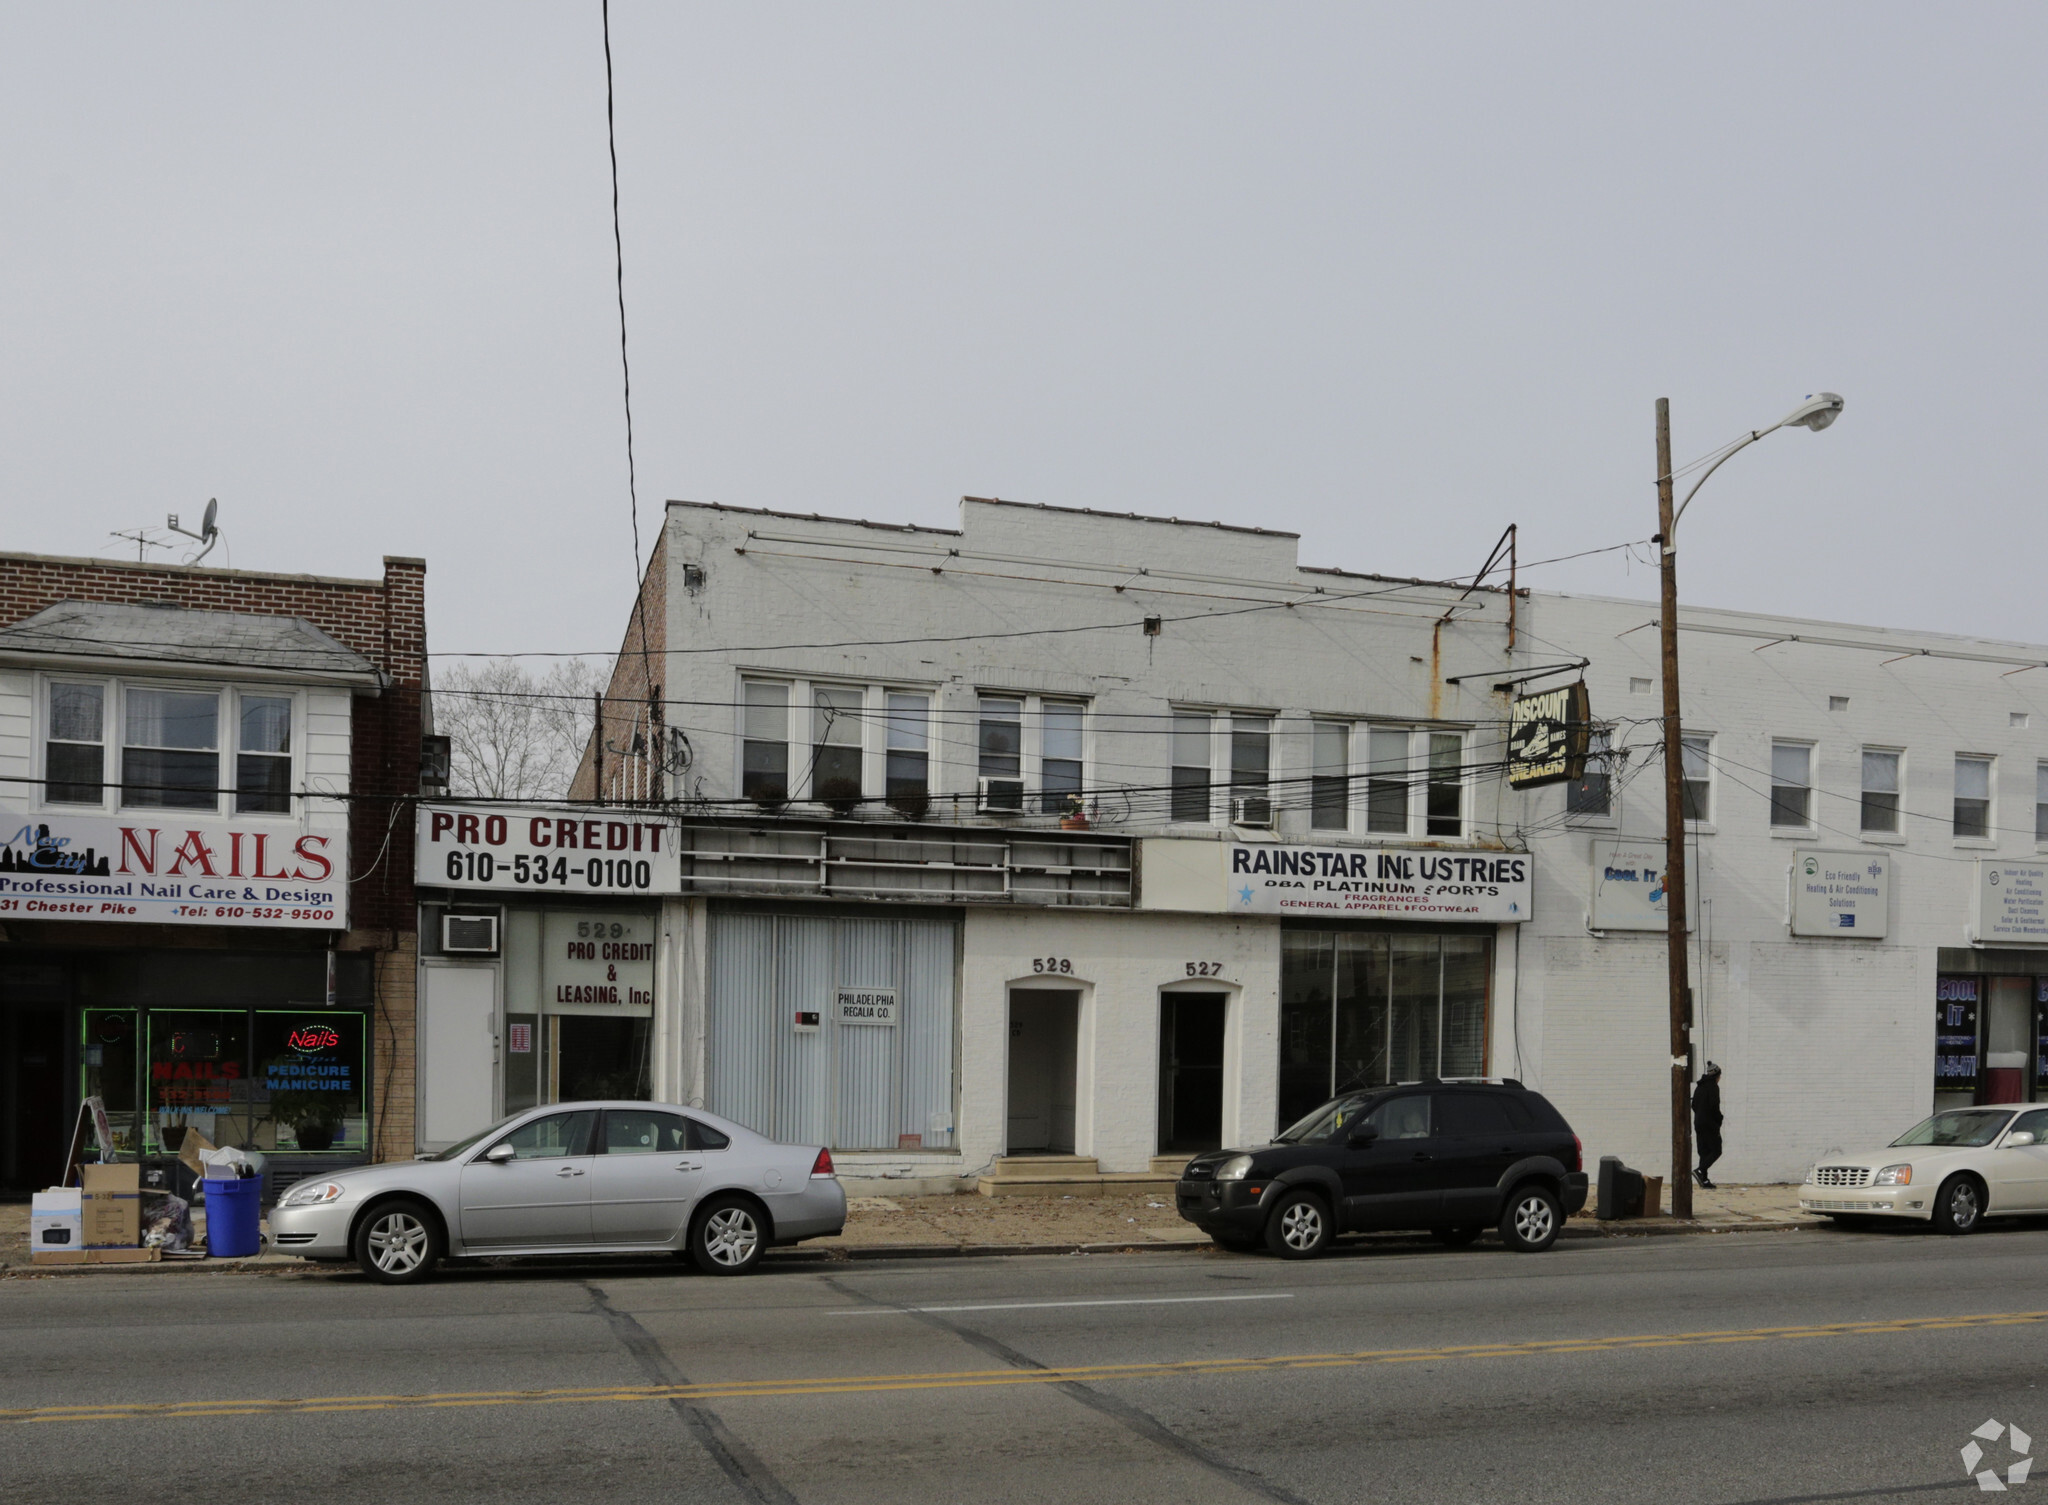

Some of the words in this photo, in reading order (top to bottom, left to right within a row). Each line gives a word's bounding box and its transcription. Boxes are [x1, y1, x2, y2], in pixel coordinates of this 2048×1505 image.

[1511, 688, 1569, 739] DISCOUNT
[0, 824, 71, 847] New
[431, 812, 507, 845] PRO
[529, 816, 667, 853] CREDIT
[30, 847, 86, 875] City
[115, 826, 334, 883] NAILS
[1233, 848, 1367, 878] RAINSTAR
[446, 850, 650, 889] 610-534-0100
[1825, 870, 1836, 880] Eco
[1838, 871, 1860, 882] Friendly
[0, 877, 132, 896] Professional
[141, 882, 182, 898] Nail
[189, 884, 236, 900] Care
[243, 886, 259, 901] &
[266, 887, 333, 906] Design
[1264, 880, 1306, 889] DBA
[1313, 880, 1415, 894] PLATINUM
[1806, 883, 1827, 894] Heating
[1829, 884, 1833, 893] &
[1835, 885, 1844, 894] Air
[1845, 884, 1878, 896] Conditioning
[1279, 900, 1340, 909] GENERAL
[1344, 903, 1401, 911] APPAREL
[1411, 905, 1479, 913] FOOTWEAR
[1344, 894, 1429, 903] FRAGRANCES
[1829, 897, 1856, 908] Solutions
[26, 900, 93, 913] Chester
[100, 903, 137, 914] Pike
[179, 905, 208, 917] Tel:
[215, 906, 334, 921] 610-532-9500
[577, 921, 623, 939] 529
[567, 941, 596, 960] PRO
[602, 942, 653, 961] CREDIT
[607, 963, 617, 982] &
[1033, 957, 1071, 974] 529
[1186, 961, 1223, 977] 527
[557, 985, 622, 1005] LEASING,
[1937, 977, 1977, 1001] COOL
[838, 993, 895, 1006] PHILADELPHIA
[843, 1006, 875, 1018] REGALIA
[877, 1007, 891, 1019] CO.
[1946, 1003, 1965, 1026] IT
[287, 1031, 340, 1047] Nails
[152, 1061, 241, 1080] NAILS
[267, 1064, 351, 1076] PEDICURE
[266, 1079, 352, 1091] MANICURE
